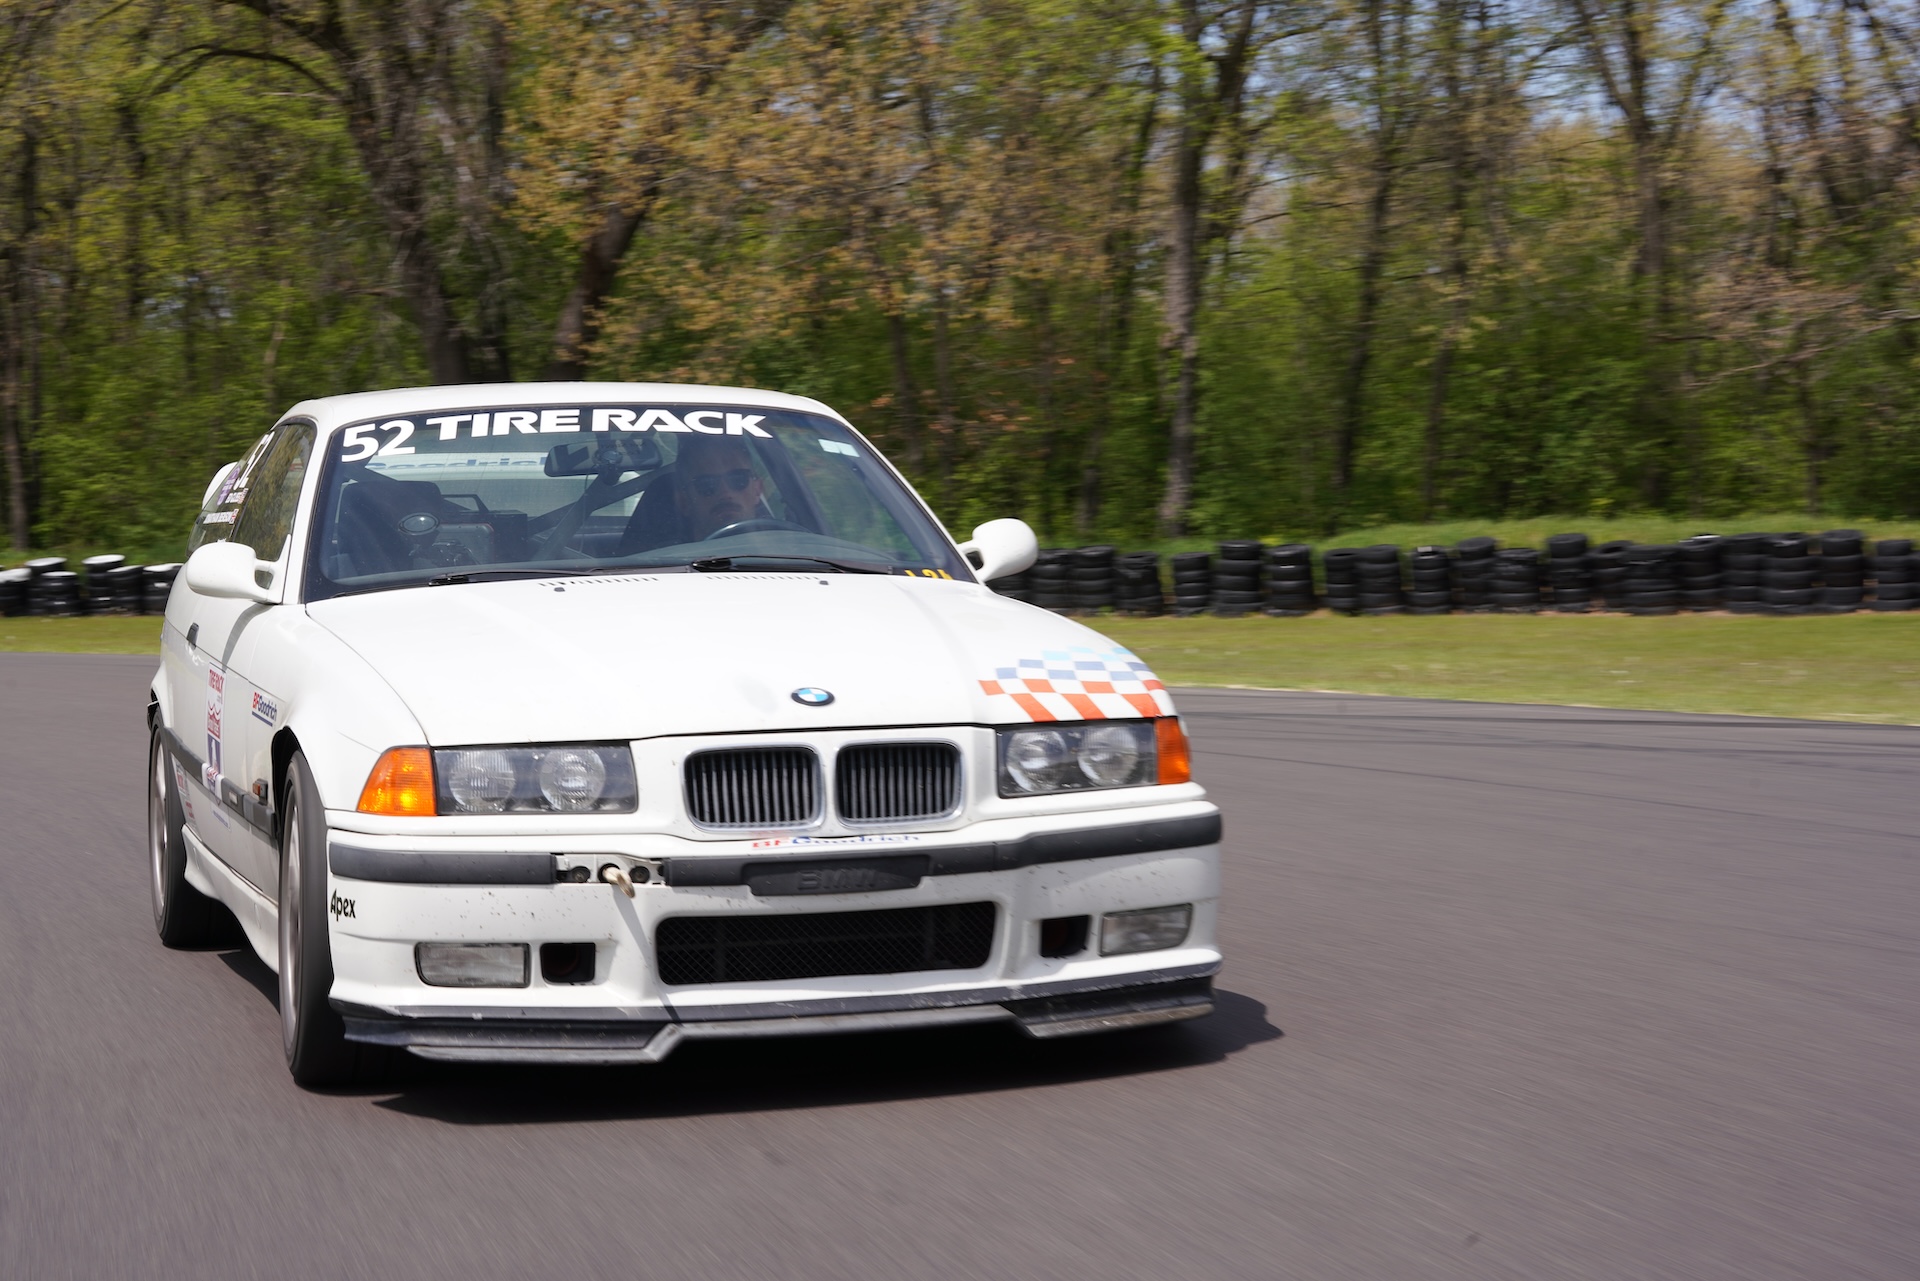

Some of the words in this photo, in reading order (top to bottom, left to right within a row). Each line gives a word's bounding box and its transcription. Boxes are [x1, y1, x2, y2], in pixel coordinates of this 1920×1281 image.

[342, 420, 415, 463] 52
[426, 409, 580, 440] TIRE
[591, 408, 774, 438] RACK
[330, 888, 356, 922] Apex
